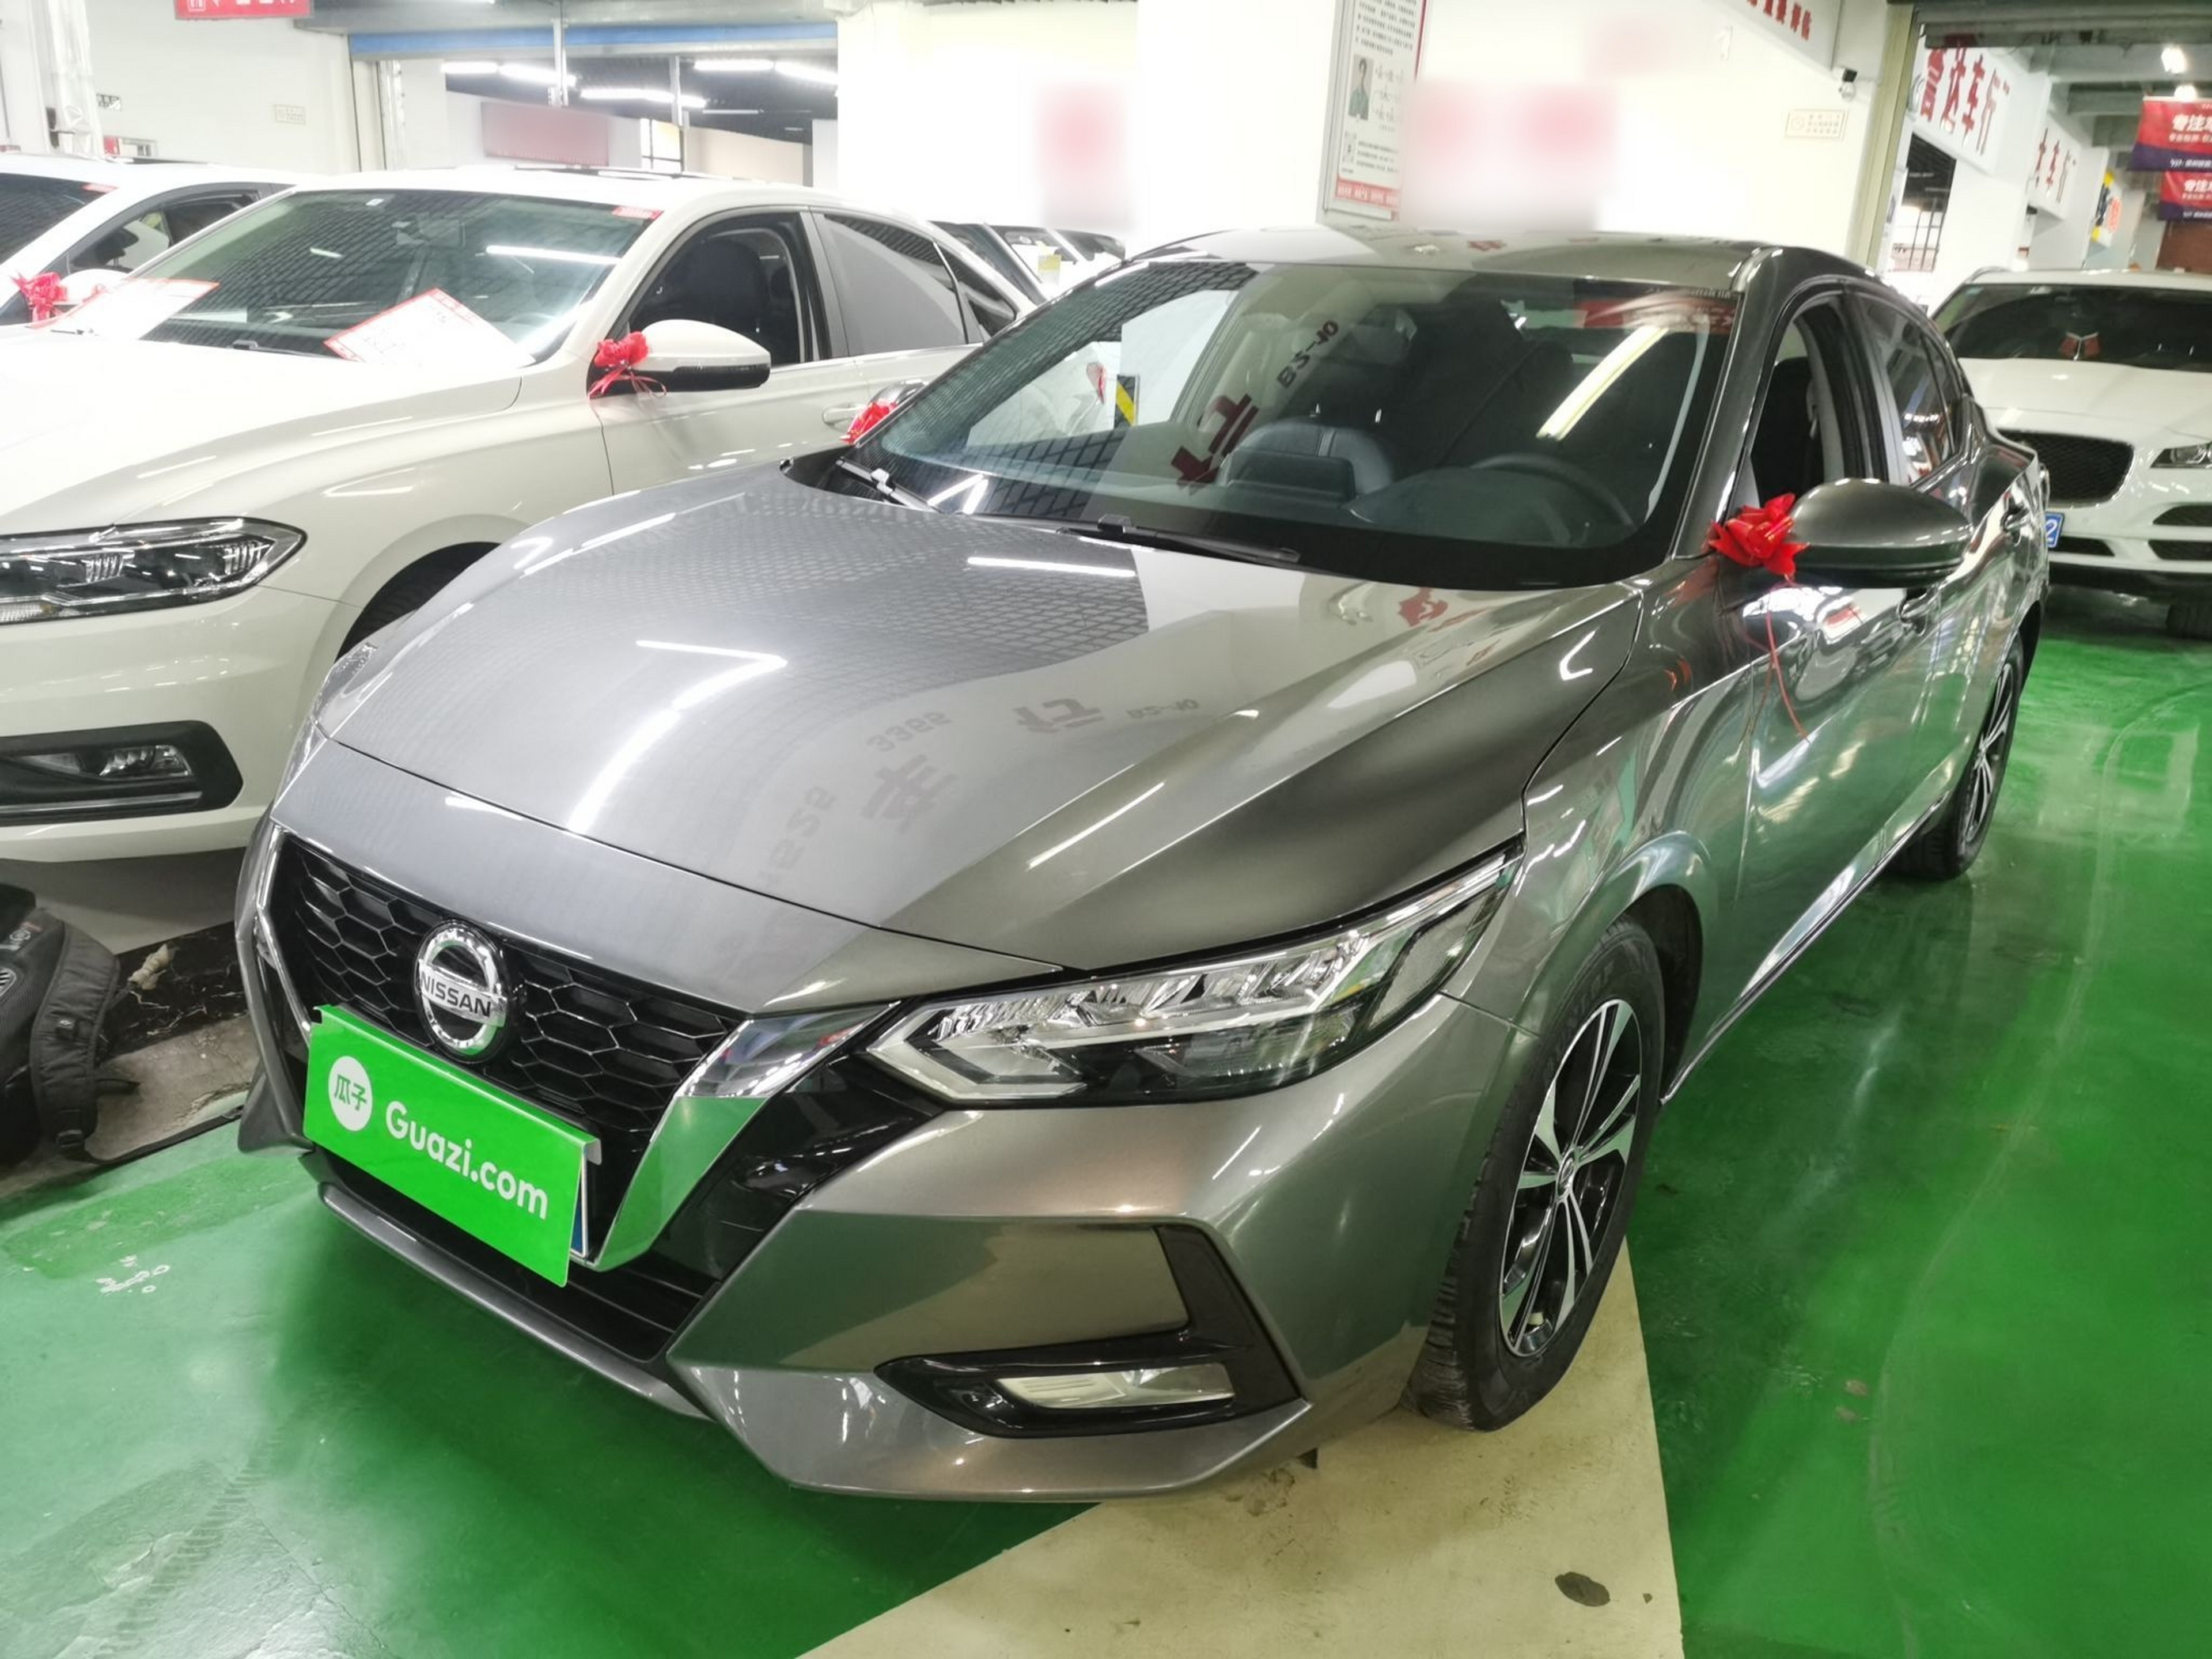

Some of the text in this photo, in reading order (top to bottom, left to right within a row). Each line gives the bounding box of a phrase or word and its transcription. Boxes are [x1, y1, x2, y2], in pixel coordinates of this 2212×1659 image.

[421, 971, 491, 1017] NISSAN
[335, 1074, 367, 1111] 瓜子
[385, 1101, 548, 1219] Guazi.com
